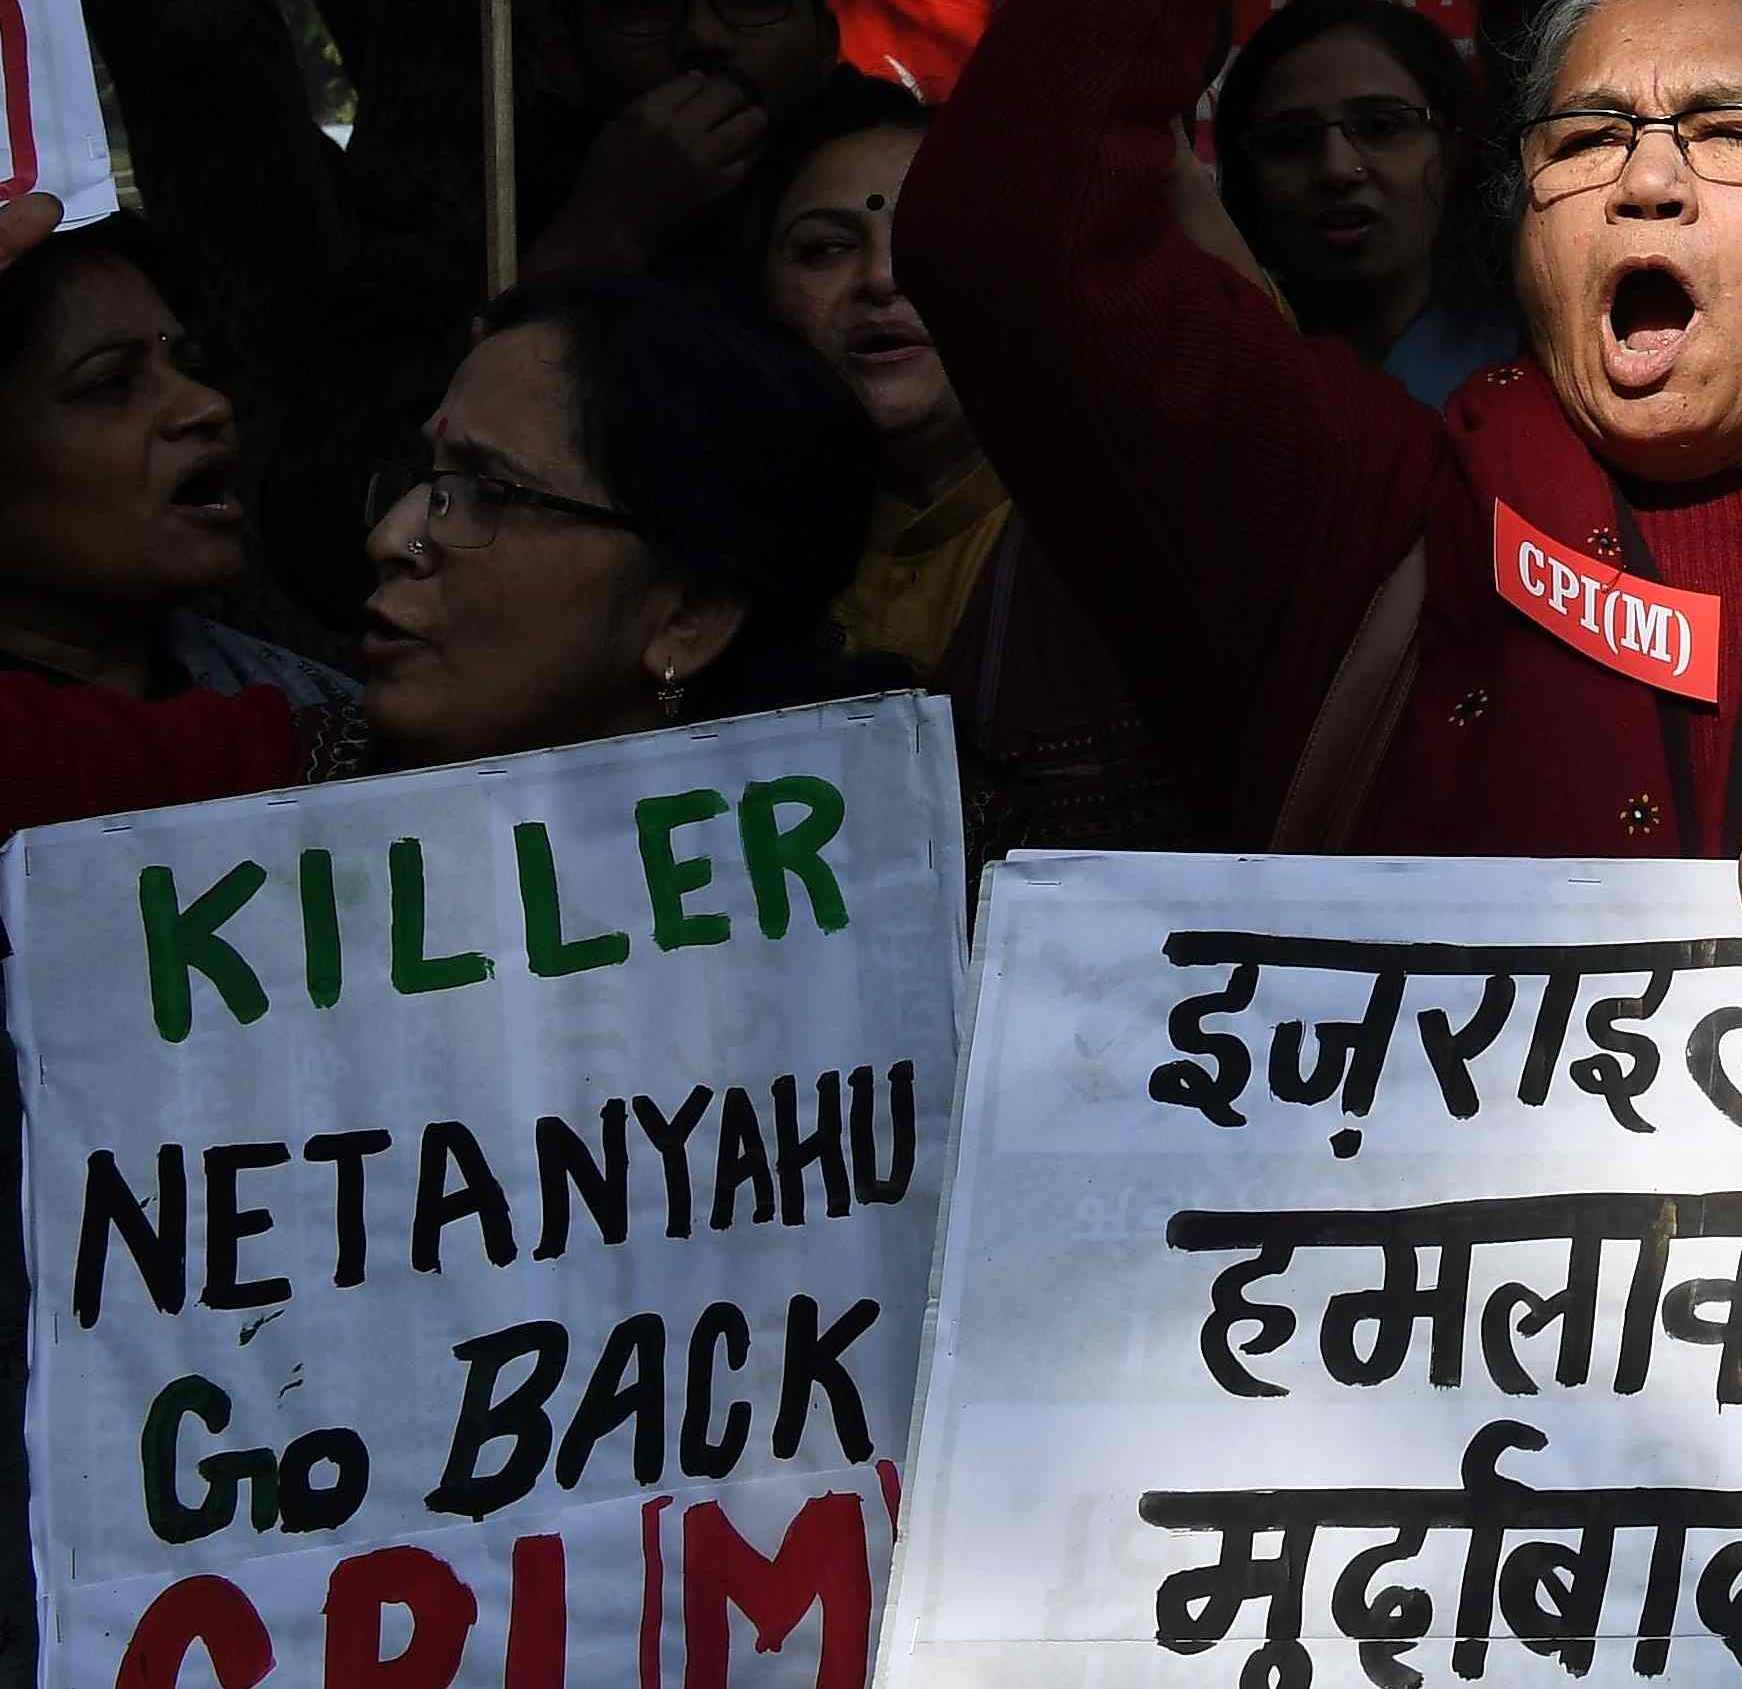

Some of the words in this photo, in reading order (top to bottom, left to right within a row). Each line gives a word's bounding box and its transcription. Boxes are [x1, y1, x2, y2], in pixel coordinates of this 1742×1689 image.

[1518, 541, 1693, 677] CPI(M)
[138, 774, 850, 1044] KILLER
[73, 1058, 916, 1330] NETANYAHU
[423, 1293, 882, 1523] BACK
